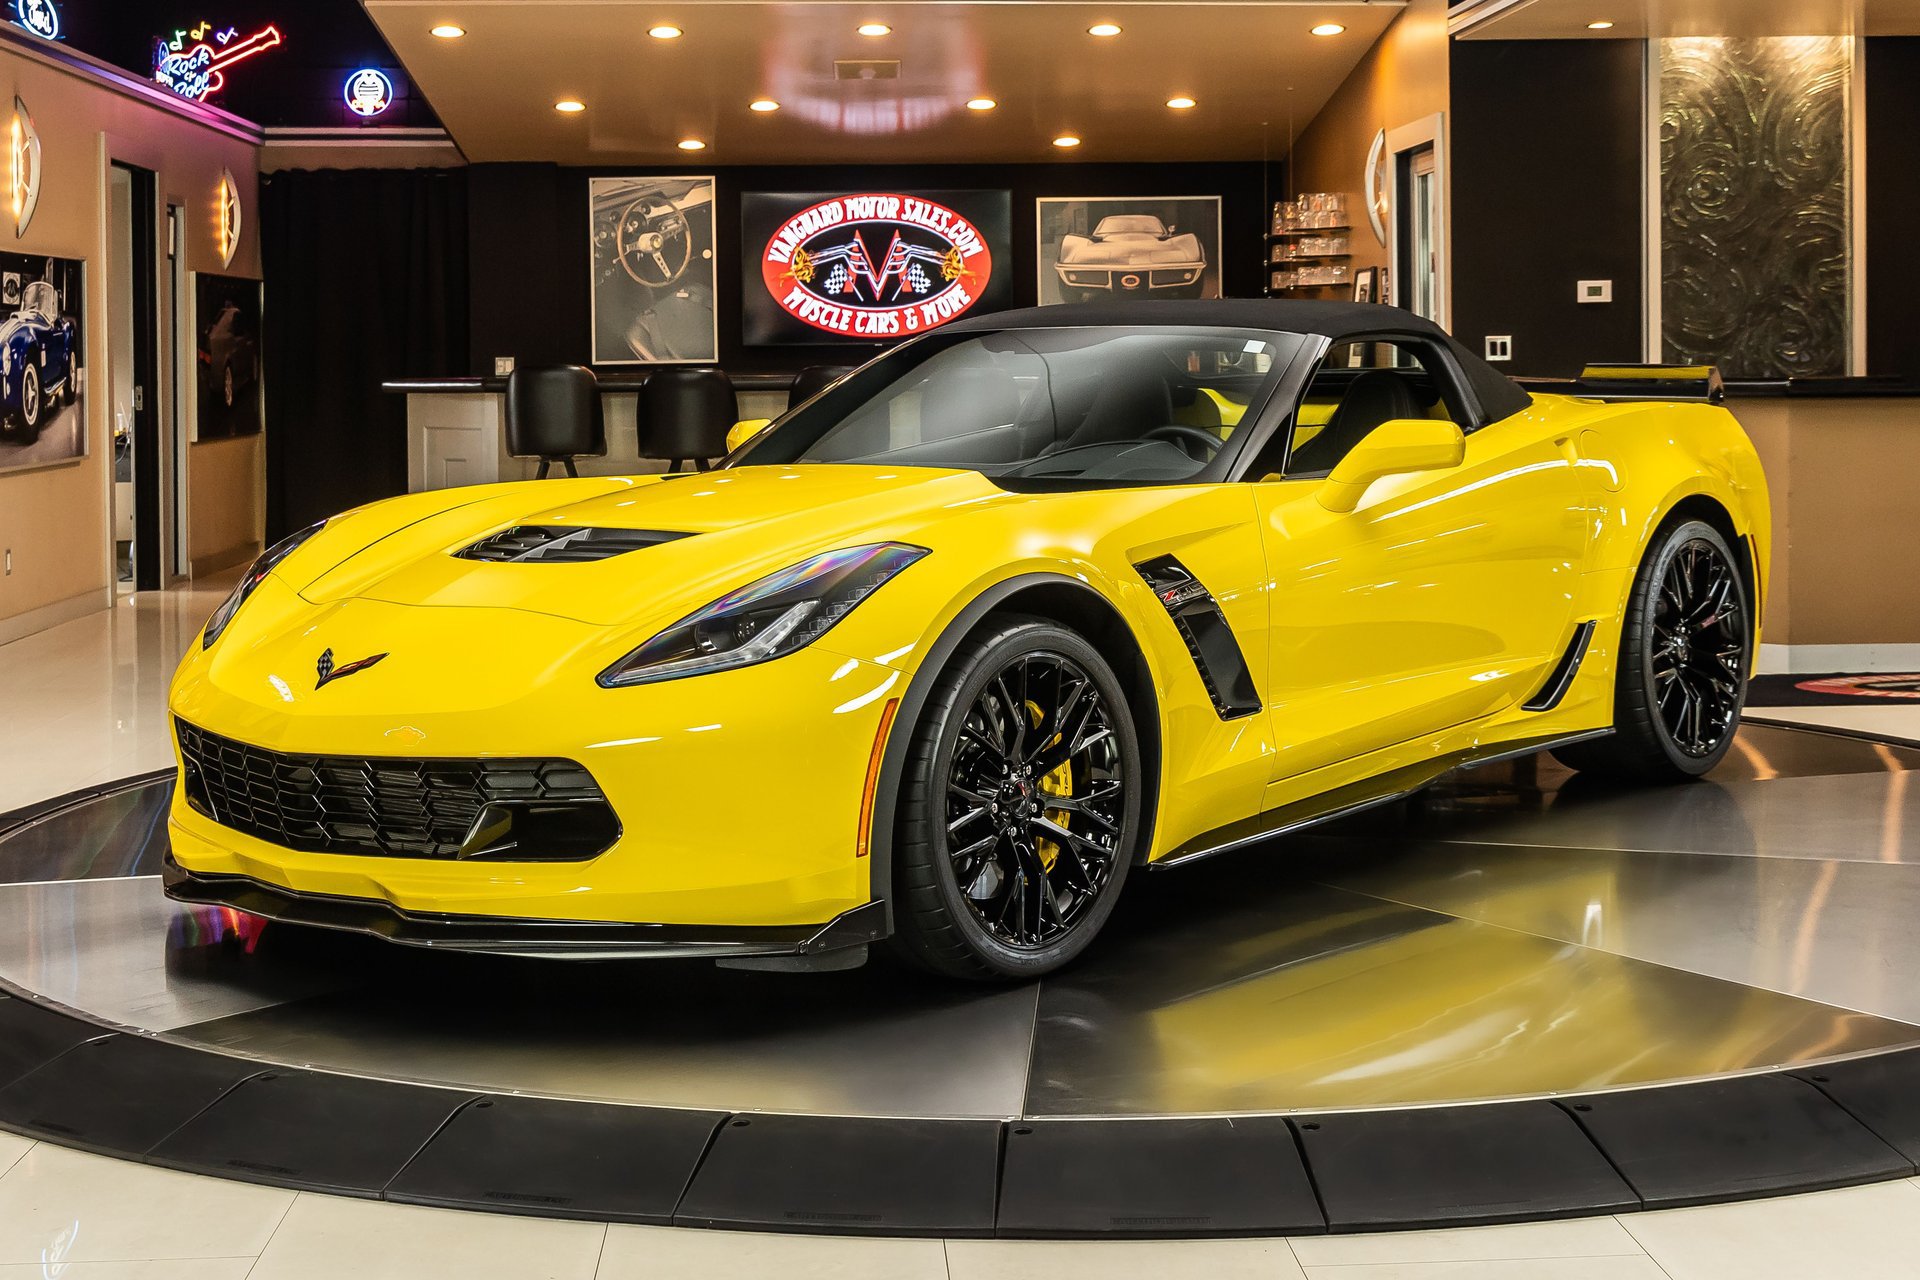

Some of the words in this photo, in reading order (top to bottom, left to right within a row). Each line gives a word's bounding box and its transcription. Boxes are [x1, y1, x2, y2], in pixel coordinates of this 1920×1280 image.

[168, 48, 210, 76] Rock
[174, 72, 209, 98] Roll
[768, 201, 843, 264] VANGUARD
[844, 196, 899, 221] MOTOR
[901, 198, 984, 258] SALES.COM
[783, 286, 854, 334] MUSCLE
[855, 310, 899, 334] CARS
[906, 307, 918, 330] &
[921, 283, 971, 326] MORE
